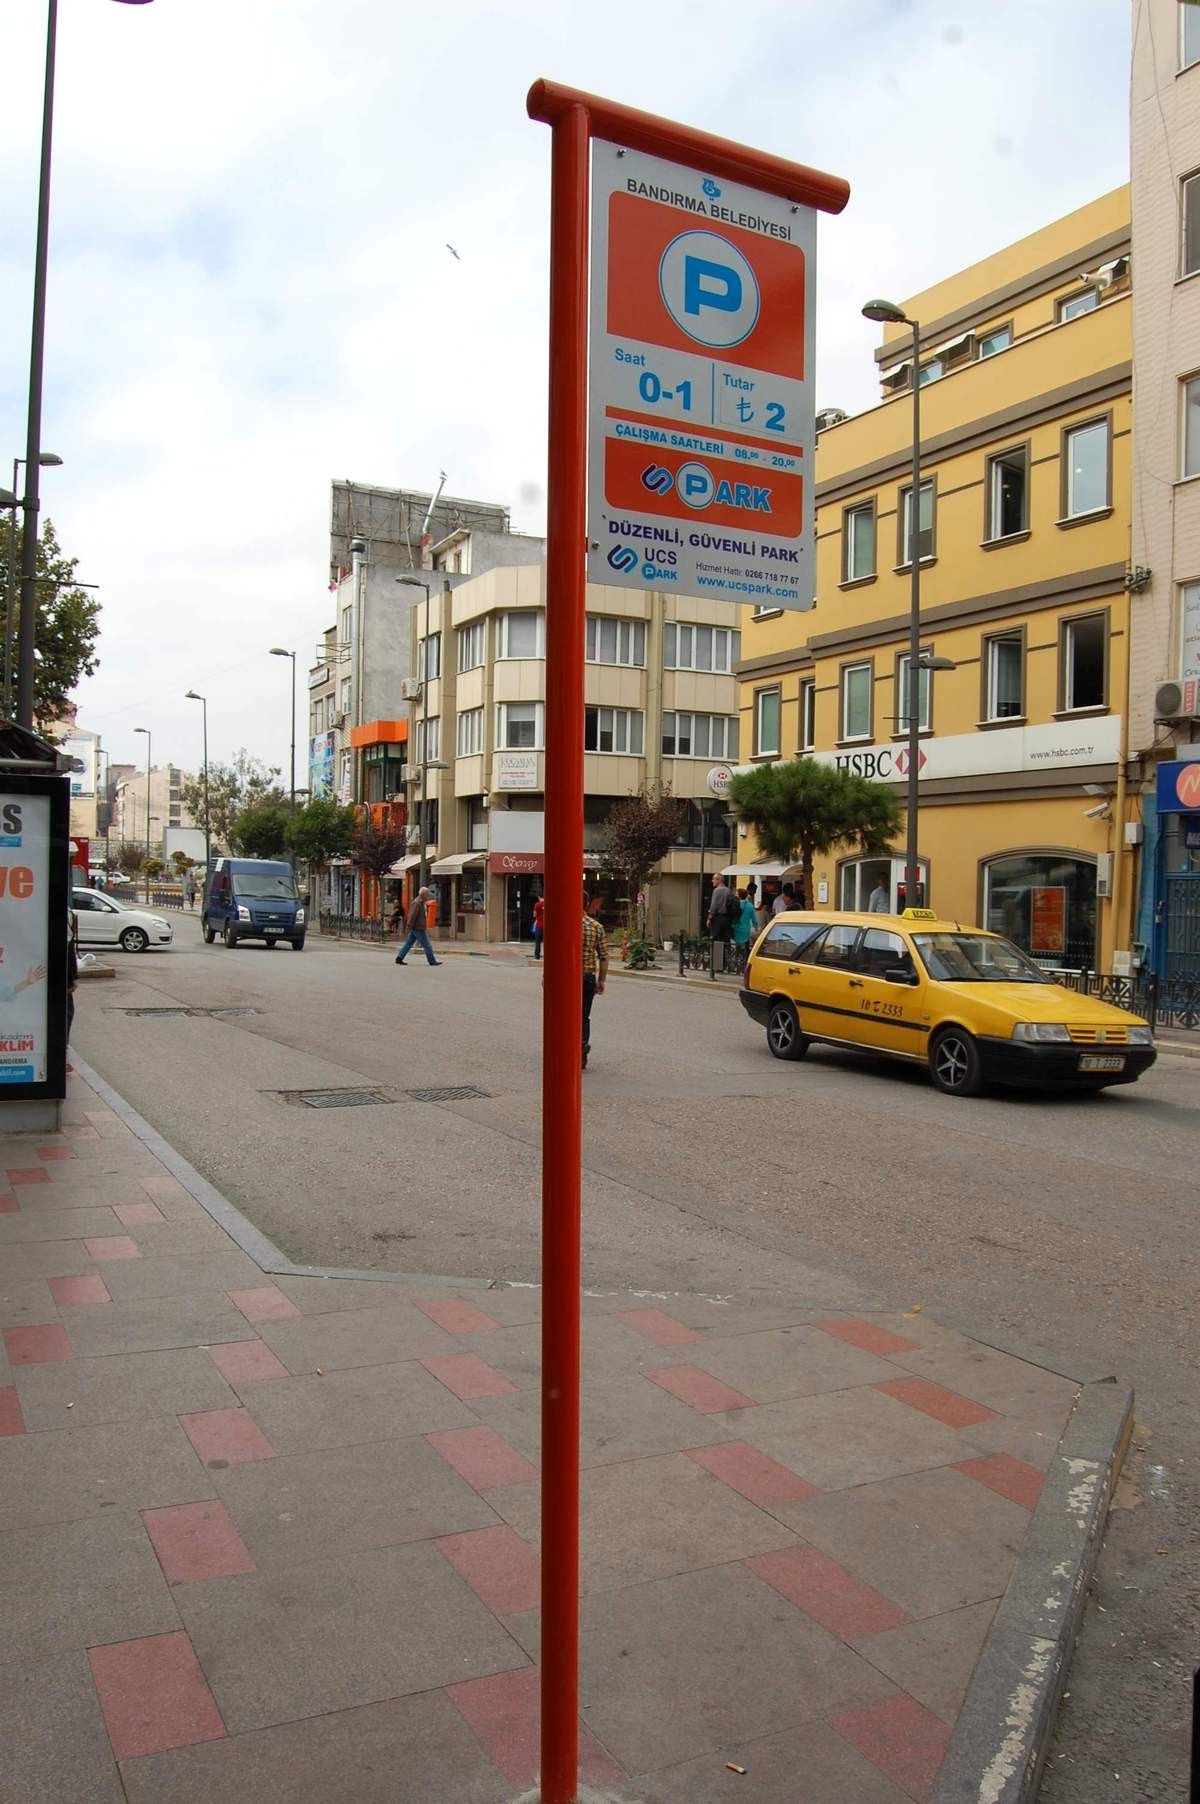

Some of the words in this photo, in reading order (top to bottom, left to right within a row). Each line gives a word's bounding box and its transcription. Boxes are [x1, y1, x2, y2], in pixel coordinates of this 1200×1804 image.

[627, 178, 707, 215] BANDIRMA
[710, 204, 791, 240] BELEDİYESİ
[684, 255, 742, 315] P
[614, 348, 646, 366] Saat
[639, 372, 692, 411] 0-1
[723, 373, 755, 391] Tutar
[765, 402, 786, 432] 2
[615, 424, 667, 443] ÇALIŞMA
[671, 434, 724, 455] SAATLERİ
[608, 520, 684, 547] DÜZENLİ,
[689, 533, 756, 556] GÜVENLİ
[760, 545, 799, 563] PARK
[644, 547, 677, 565] UCS
[696, 562, 722, 573] Hizmet
[697, 575, 799, 598] www.ucspark.com
[835, 750, 892, 779] HSBC
[1029, 746, 1094, 759] www.hsbc.com.tr
